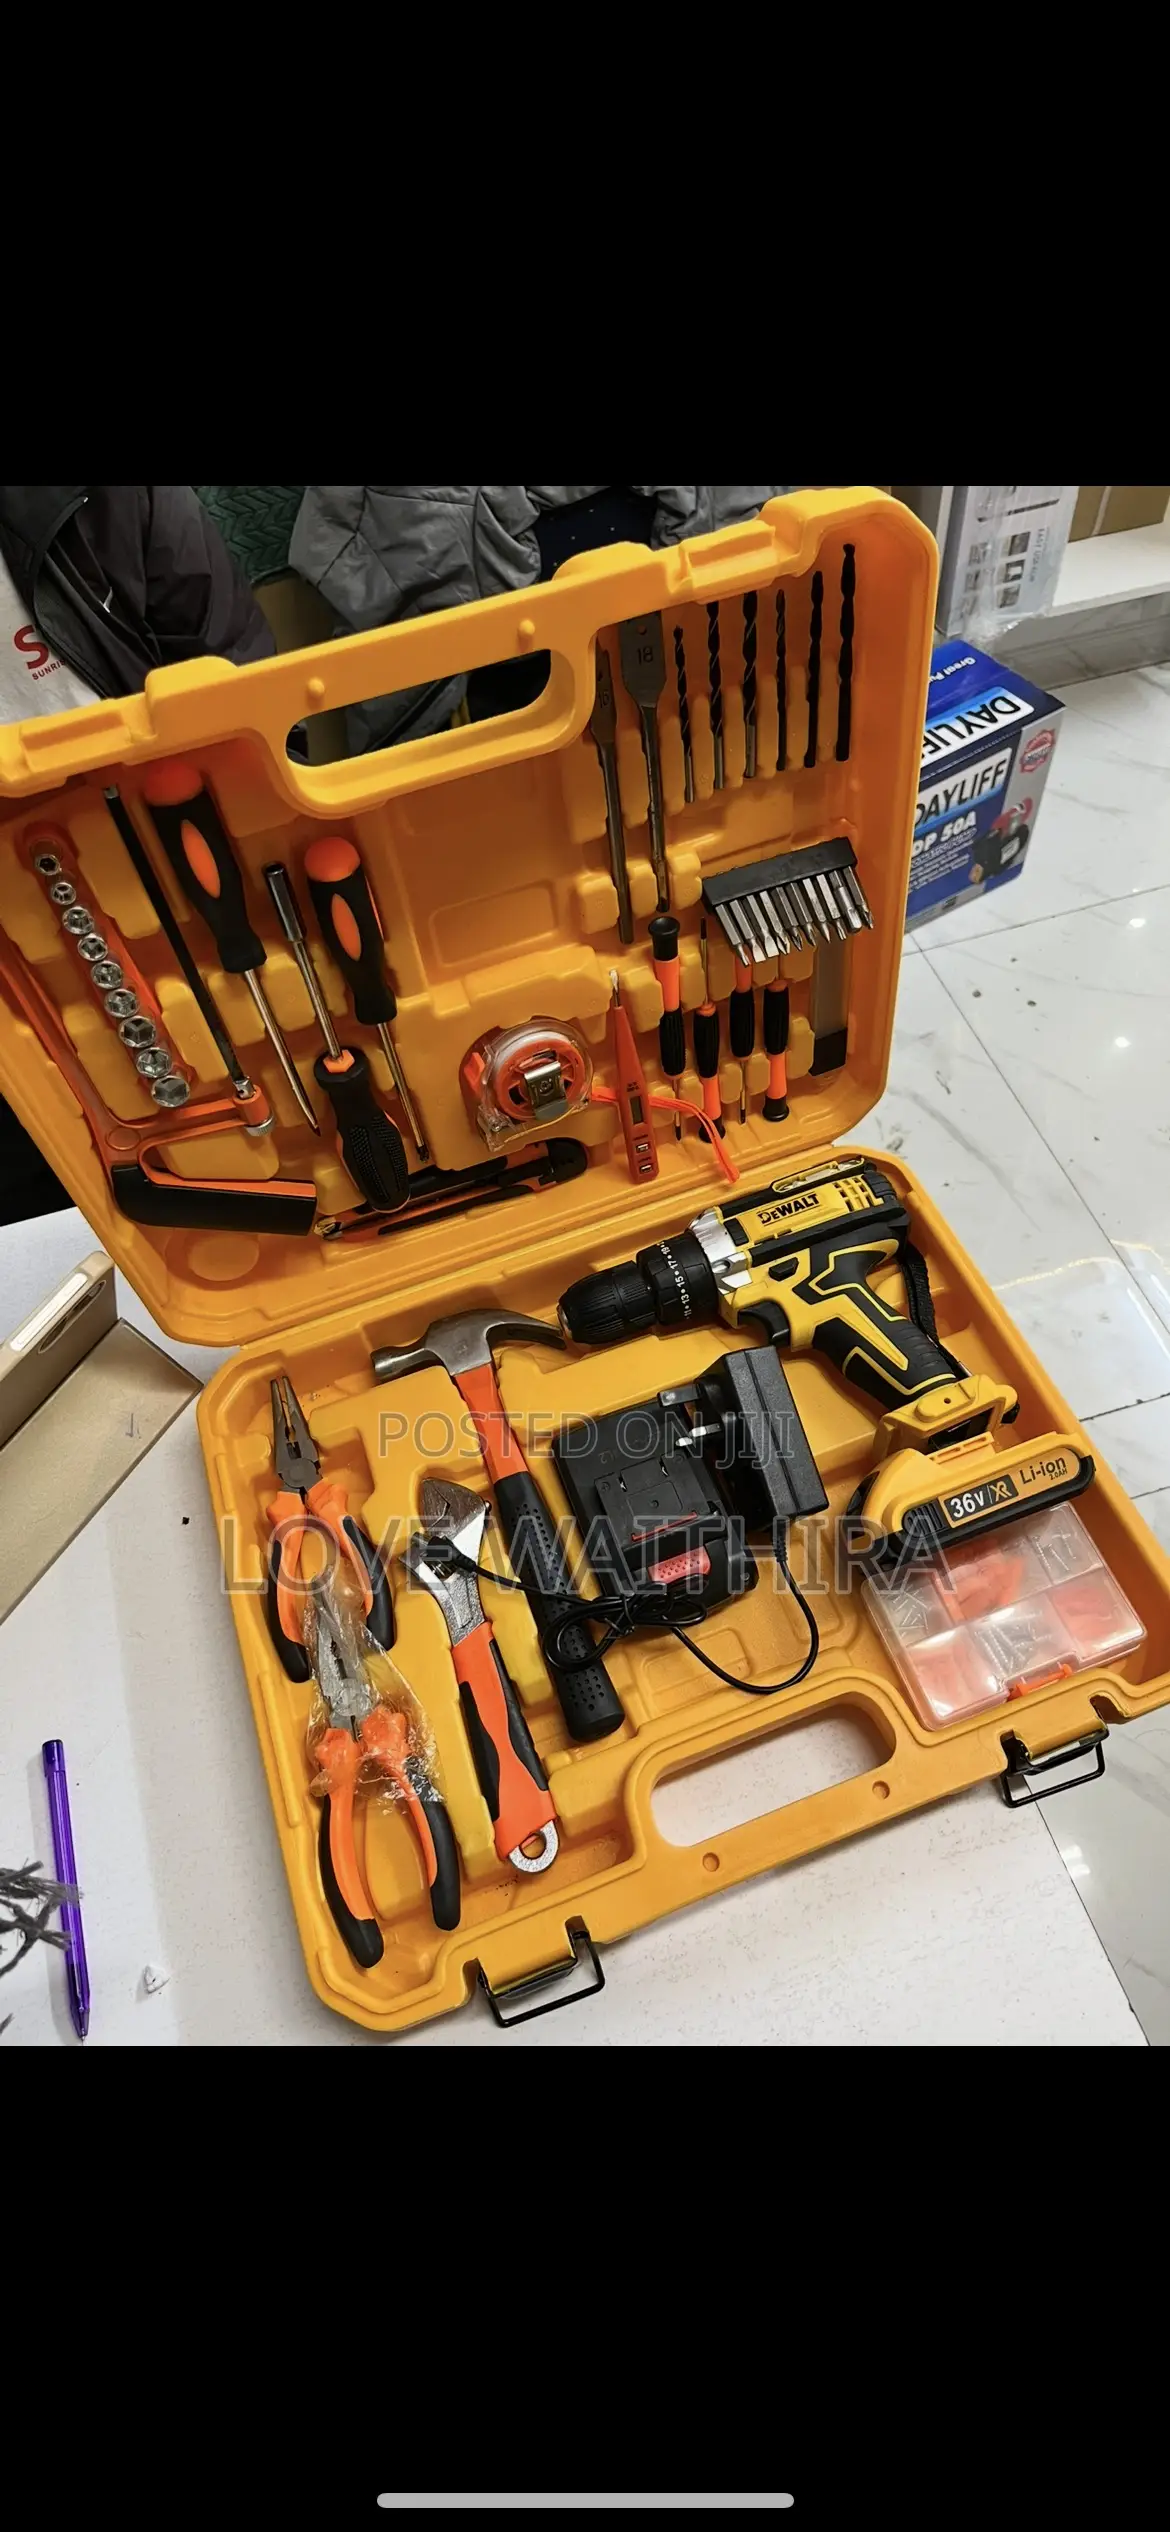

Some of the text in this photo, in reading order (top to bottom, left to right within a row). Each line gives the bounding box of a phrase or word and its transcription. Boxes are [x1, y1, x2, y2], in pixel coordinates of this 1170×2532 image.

[14, 624, 49, 669] S
[637, 646, 653, 665] 18
[921, 696, 1021, 759] DAYLIF
[941, 811, 976, 842] 50A
[757, 1193, 820, 1224] DEWALT
[667, 1260, 679, 1270] 17
[674, 1276, 685, 1288] 15
[681, 1294, 690, 1304] 13
[1019, 1457, 1066, 1484] Li-ion
